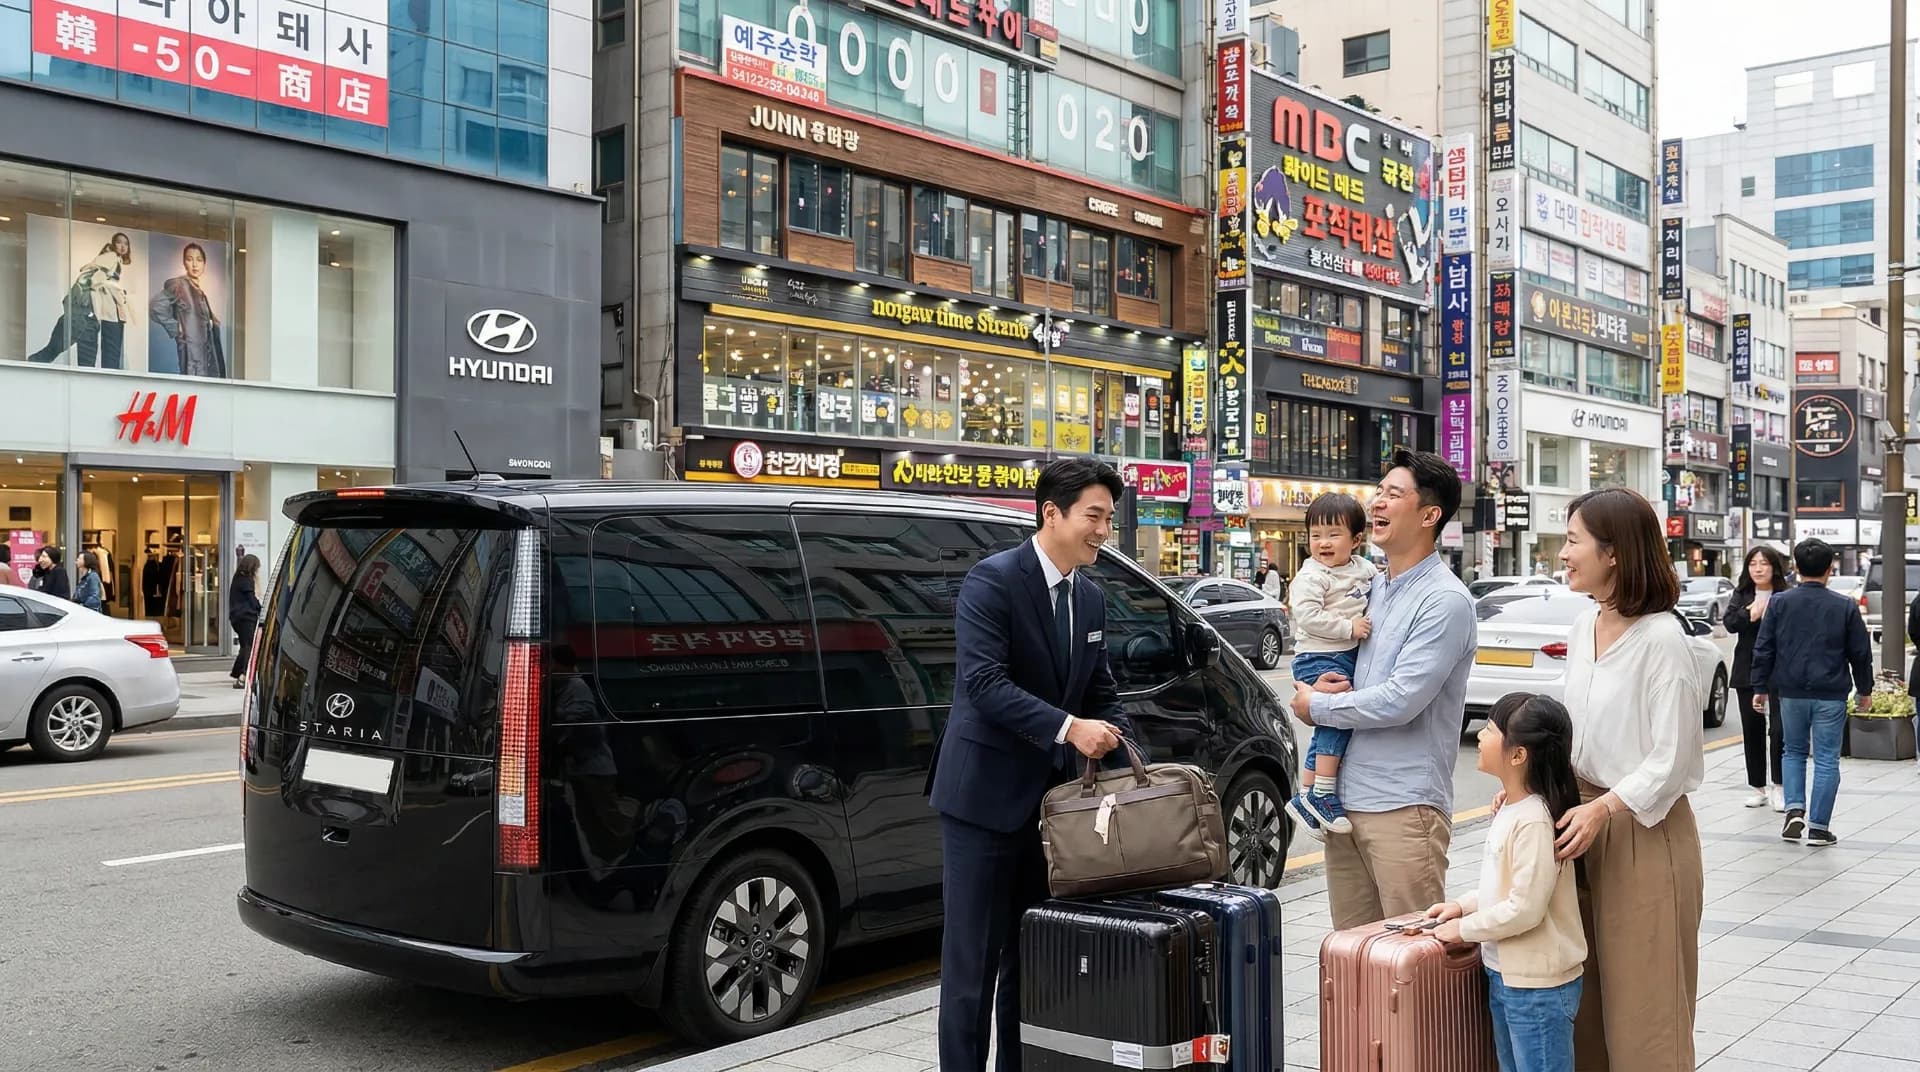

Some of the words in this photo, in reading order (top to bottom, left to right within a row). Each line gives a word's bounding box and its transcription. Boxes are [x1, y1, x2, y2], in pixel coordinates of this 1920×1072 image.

[55, 10, 98, 56] 韓
[750, 104, 807, 140] JUNN
[1273, 95, 1371, 174] MBC
[936, 307, 974, 330] time
[448, 355, 554, 386] HYUNDAI
[116, 391, 197, 447] H&M
[299, 721, 382, 741] STARIA
